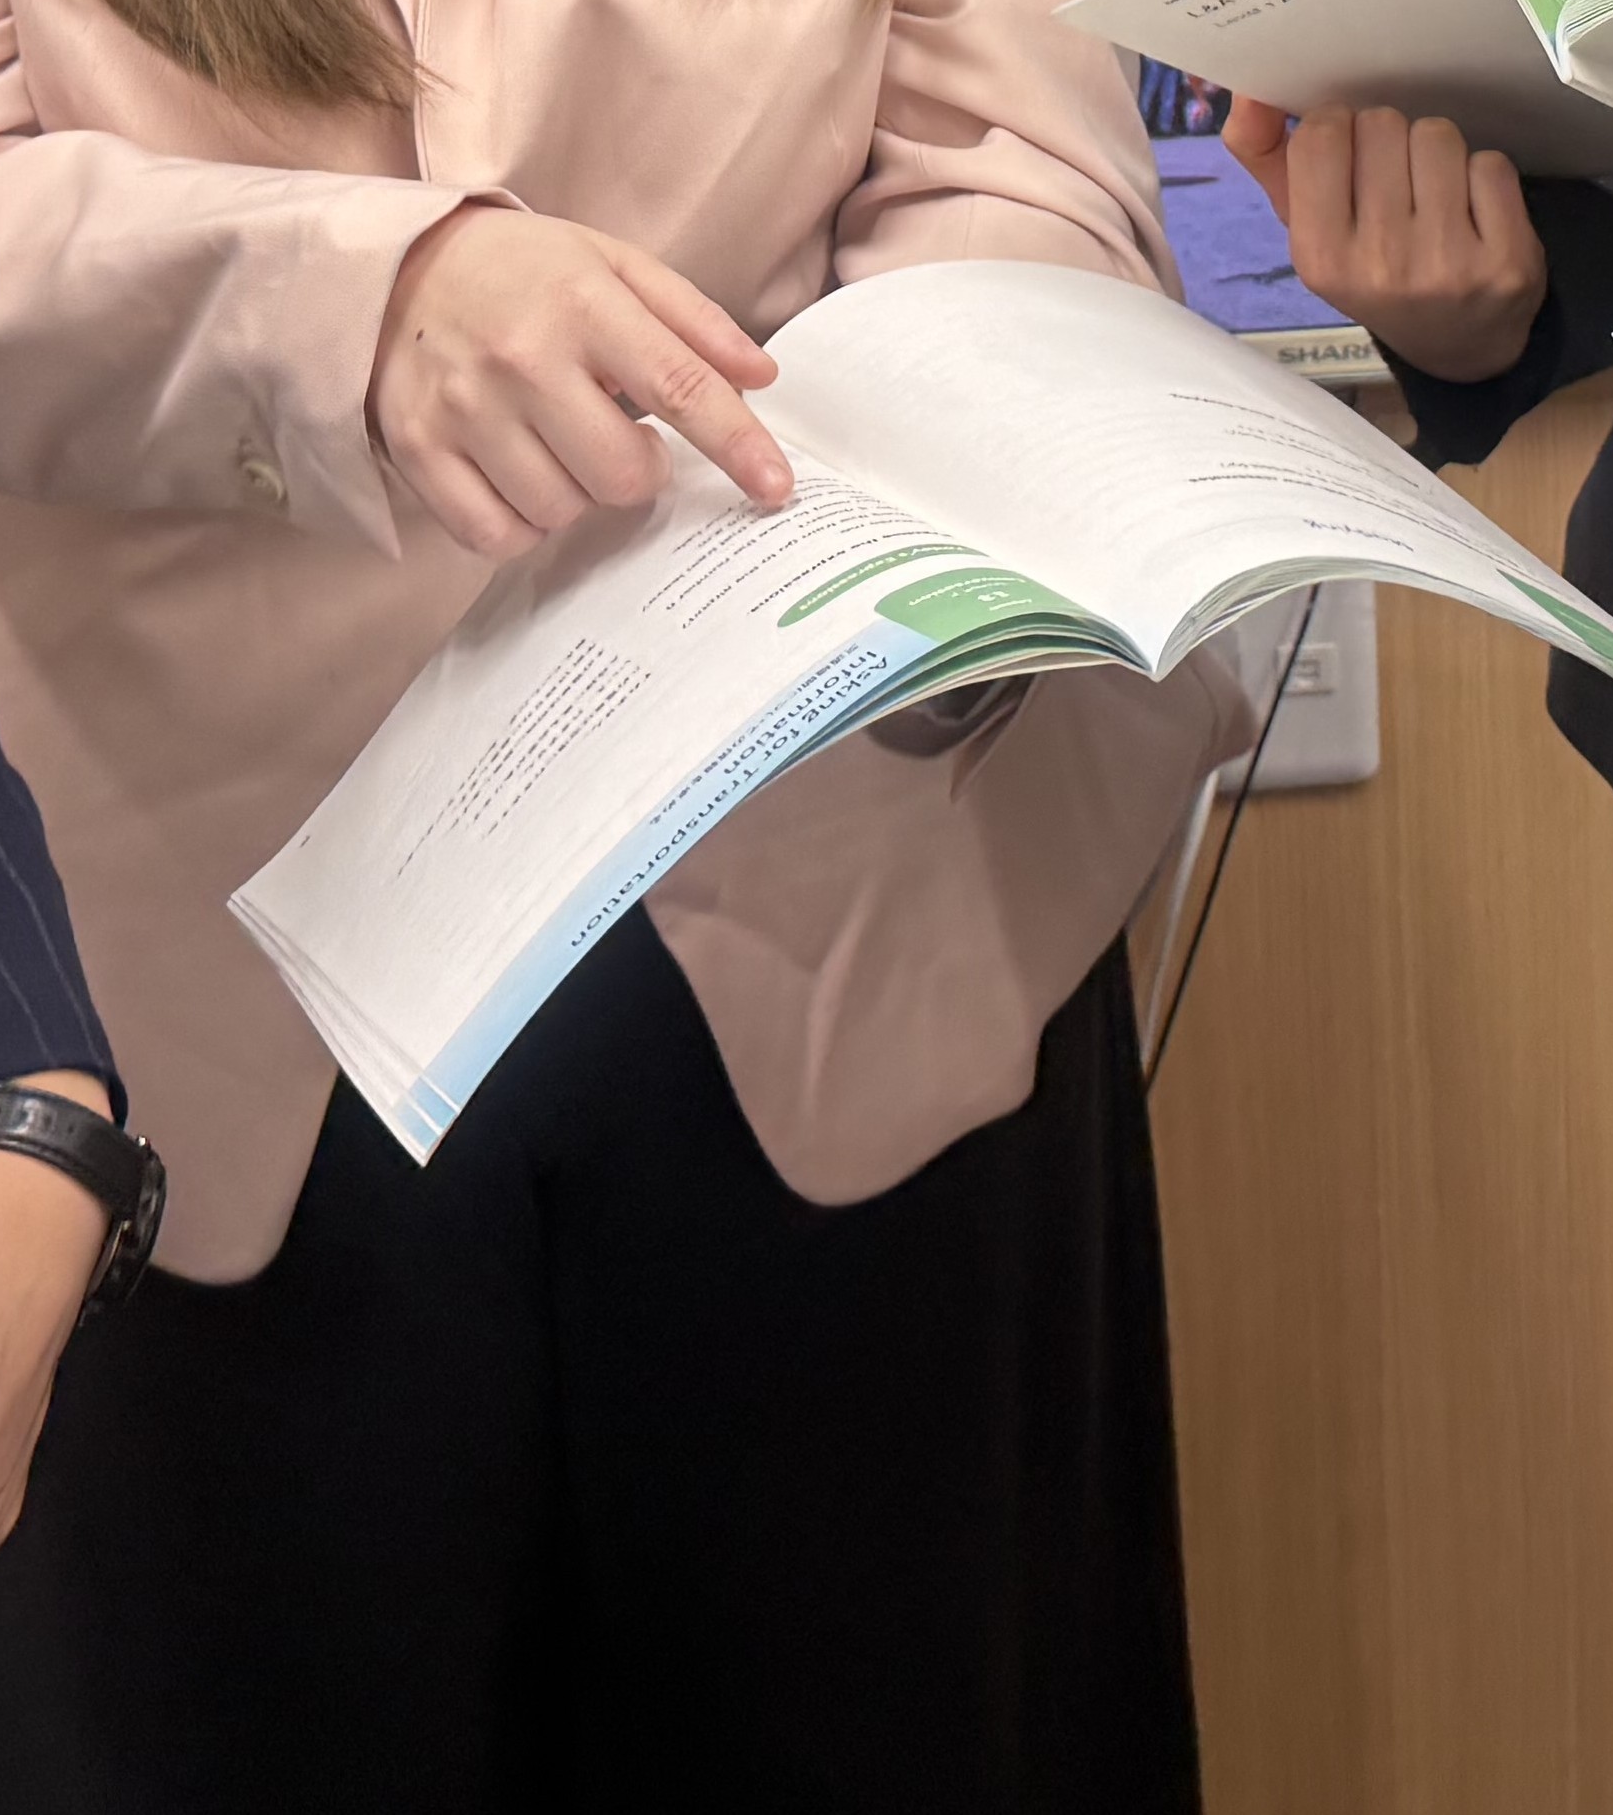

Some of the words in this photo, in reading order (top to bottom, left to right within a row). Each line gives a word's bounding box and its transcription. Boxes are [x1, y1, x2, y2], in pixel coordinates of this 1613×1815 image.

[723, 649, 878, 777] Information
[802, 653, 888, 726] Asking
[760, 725, 801, 762] for
[569, 764, 761, 950] Transportation
